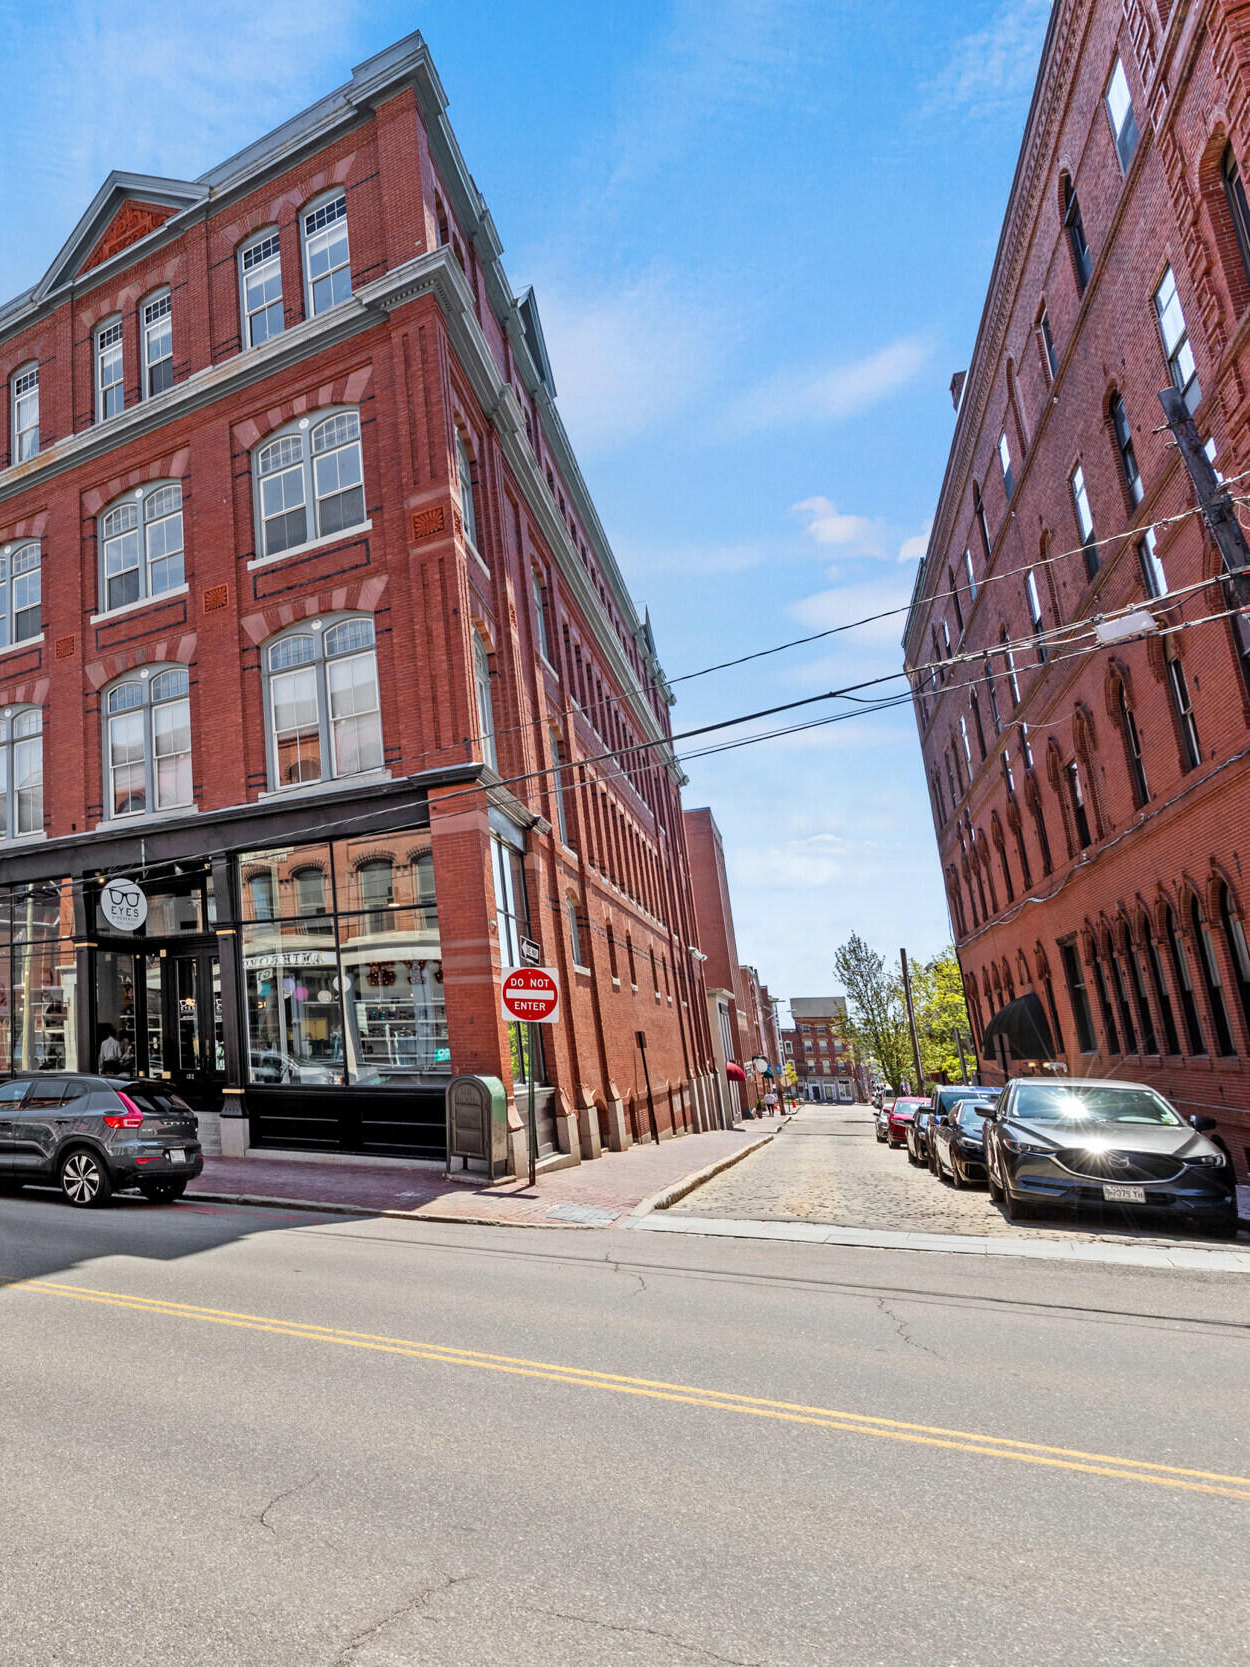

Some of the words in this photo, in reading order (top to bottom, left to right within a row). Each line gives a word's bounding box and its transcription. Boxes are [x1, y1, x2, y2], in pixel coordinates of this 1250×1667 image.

[111, 905, 140, 918] EYES
[510, 978, 525, 987] DO
[530, 978, 549, 988] NOT
[514, 1001, 546, 1011] ENTER
